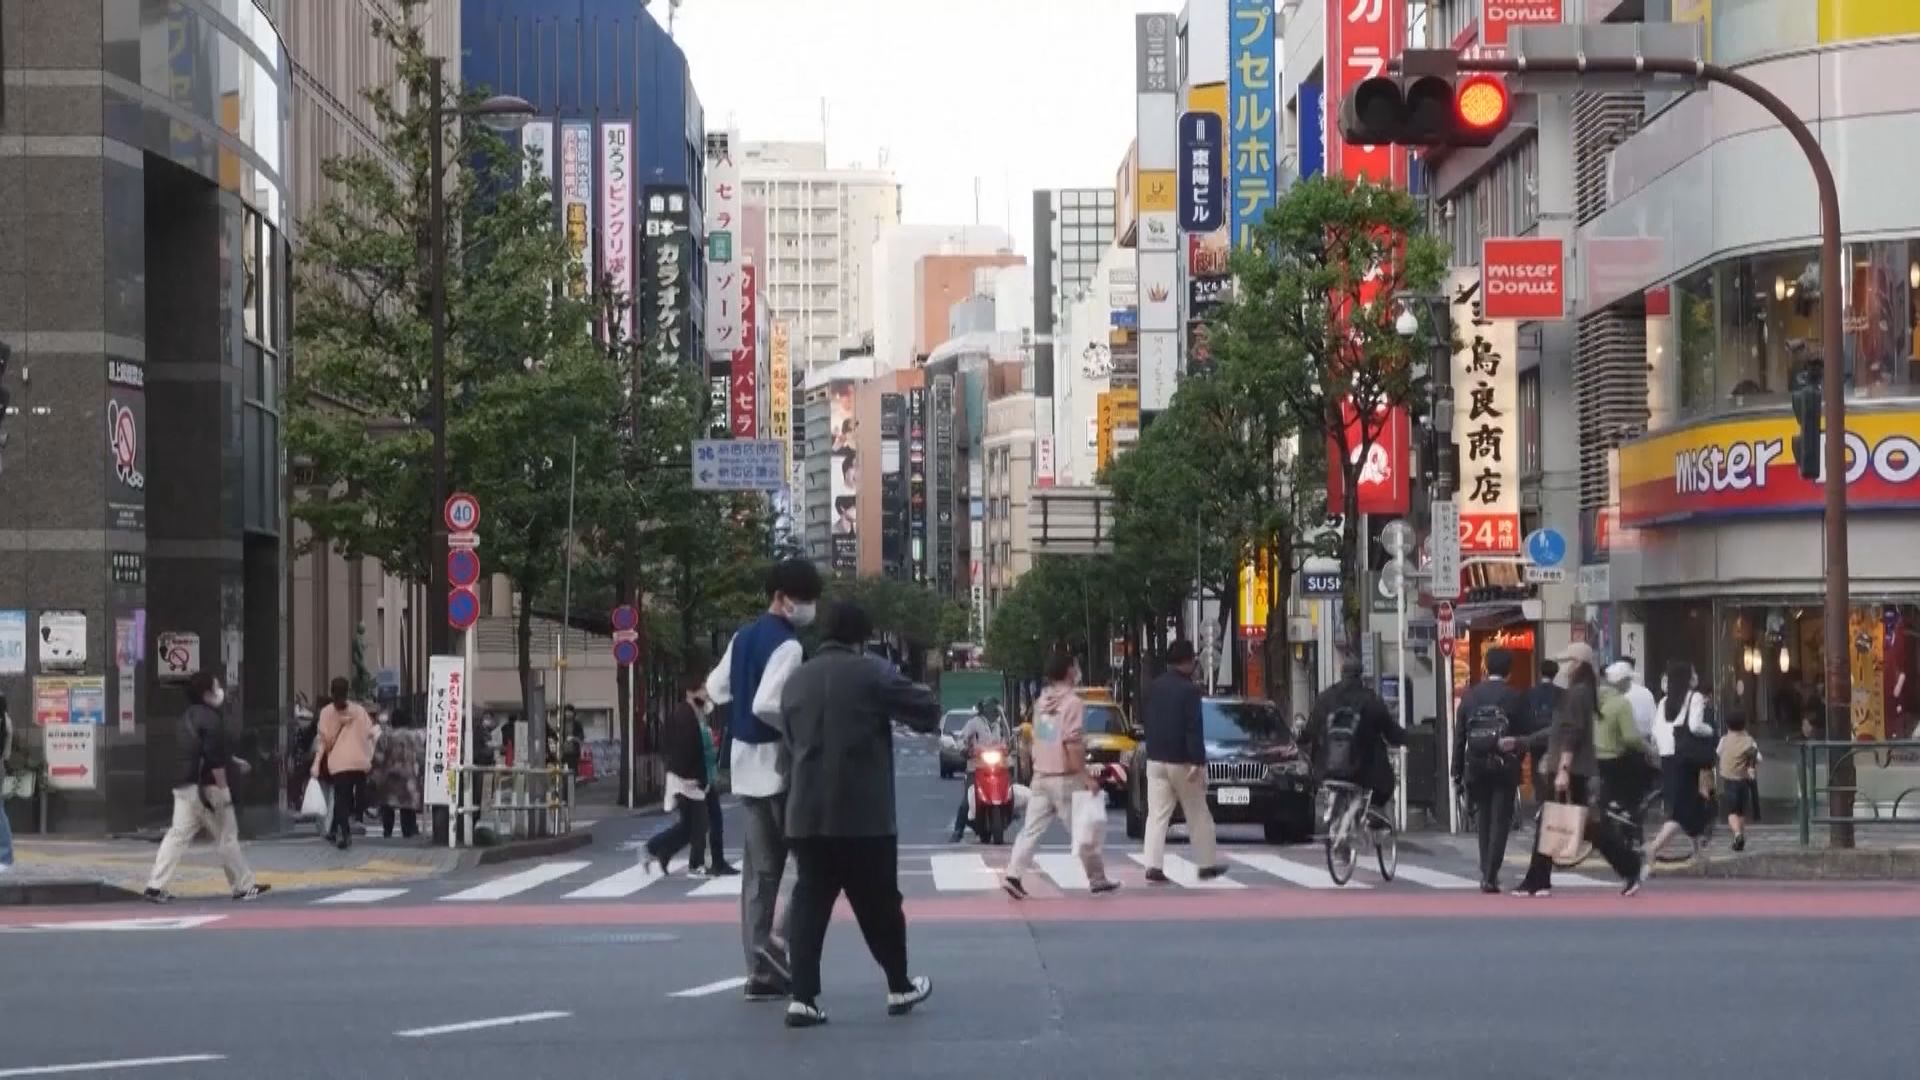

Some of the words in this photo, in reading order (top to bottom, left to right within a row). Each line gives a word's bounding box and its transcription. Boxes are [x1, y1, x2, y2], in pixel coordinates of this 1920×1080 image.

[1487, 7, 1557, 20] Donut
[1235, 0, 1271, 253] プセルホテル
[646, 219, 688, 237] 日本一
[1487, 280, 1558, 295] Donut
[1675, 439, 1783, 494] mister
[453, 505, 471, 521] 40
[1459, 521, 1495, 548] 24
[1498, 520, 1514, 549] 時間
